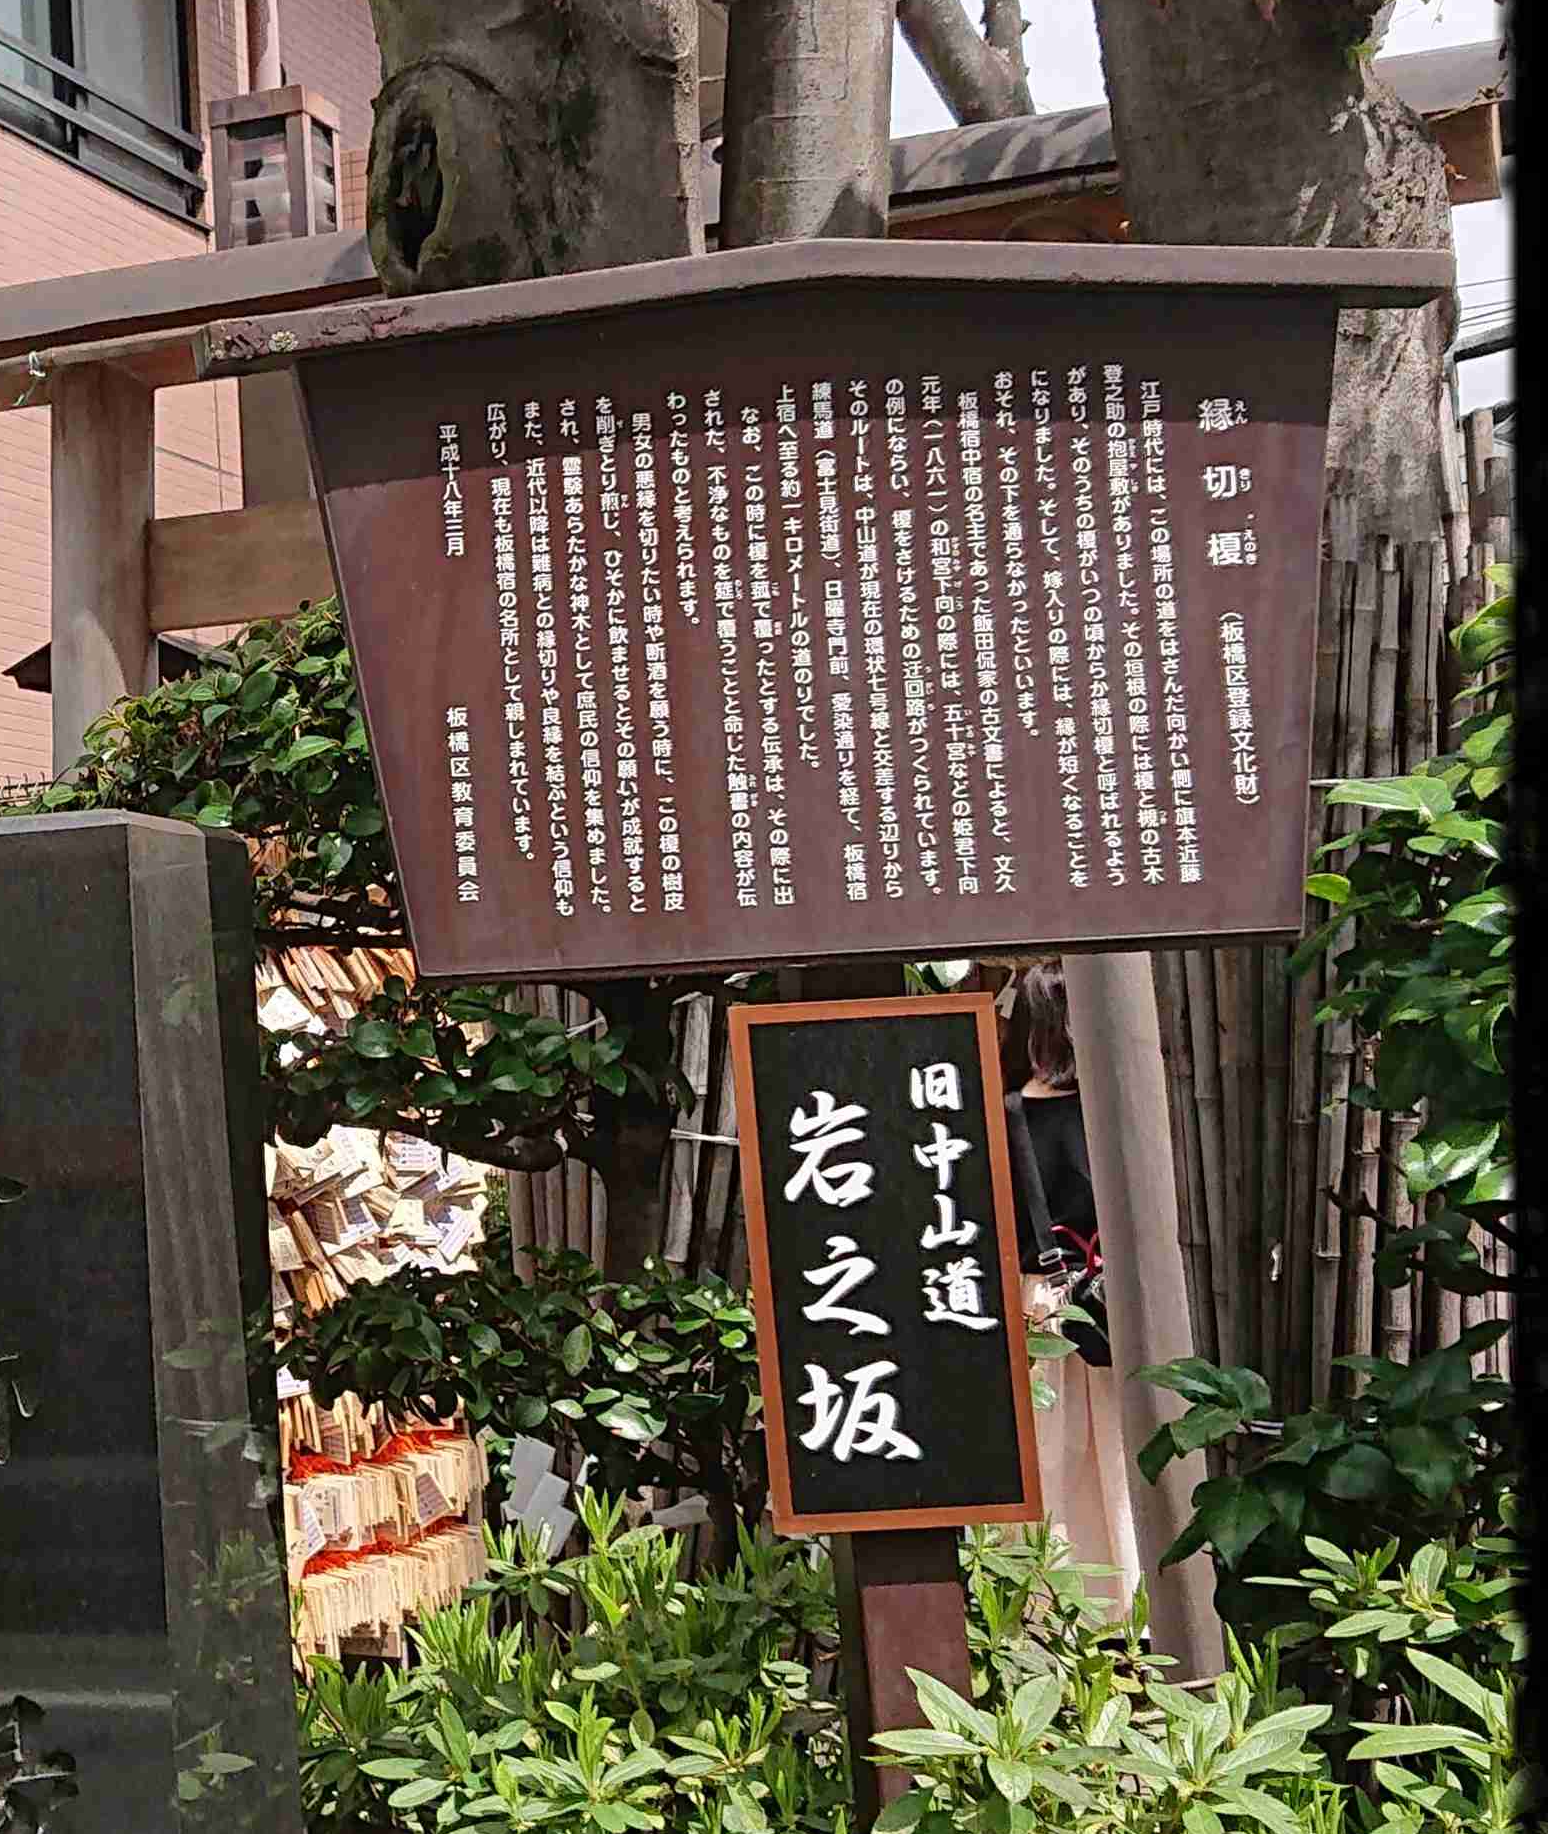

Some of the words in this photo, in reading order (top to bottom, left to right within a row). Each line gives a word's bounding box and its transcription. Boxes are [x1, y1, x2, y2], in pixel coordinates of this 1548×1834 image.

[438, 424, 464, 557] 平成十八年三月
[1197, 398, 1244, 566] 縁切榎
[446, 707, 480, 902] 板橋区教育委員会
[784, 1090, 923, 1462] 岩之坂
[909, 1061, 999, 1330] 旧中山道
